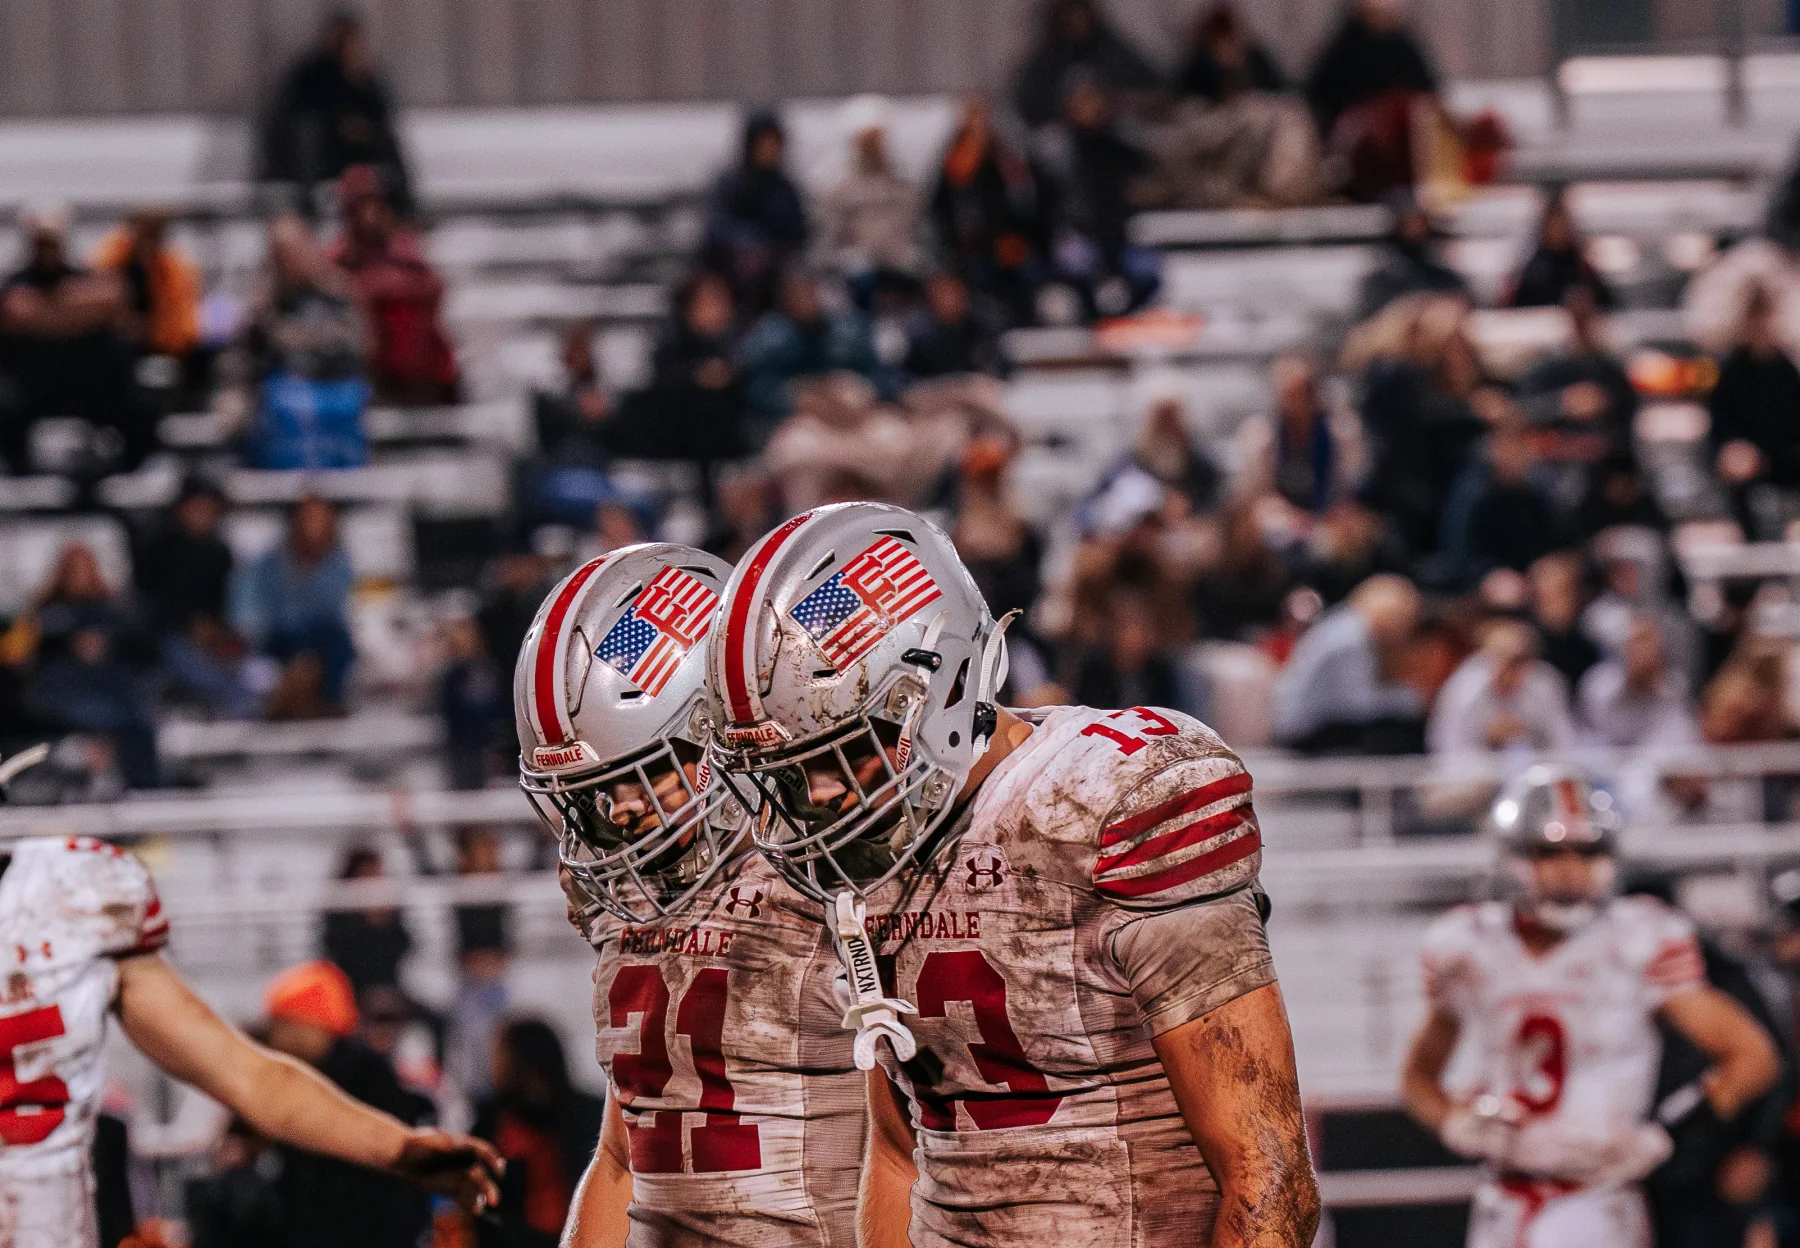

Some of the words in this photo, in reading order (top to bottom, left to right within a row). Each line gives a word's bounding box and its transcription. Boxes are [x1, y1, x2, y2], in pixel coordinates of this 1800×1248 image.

[535, 747, 584, 767] FERNDALE
[1080, 705, 1178, 757] 13
[847, 937, 878, 994] NXTRND
[608, 964, 763, 1174] 21
[1511, 1013, 1567, 1118] 3
